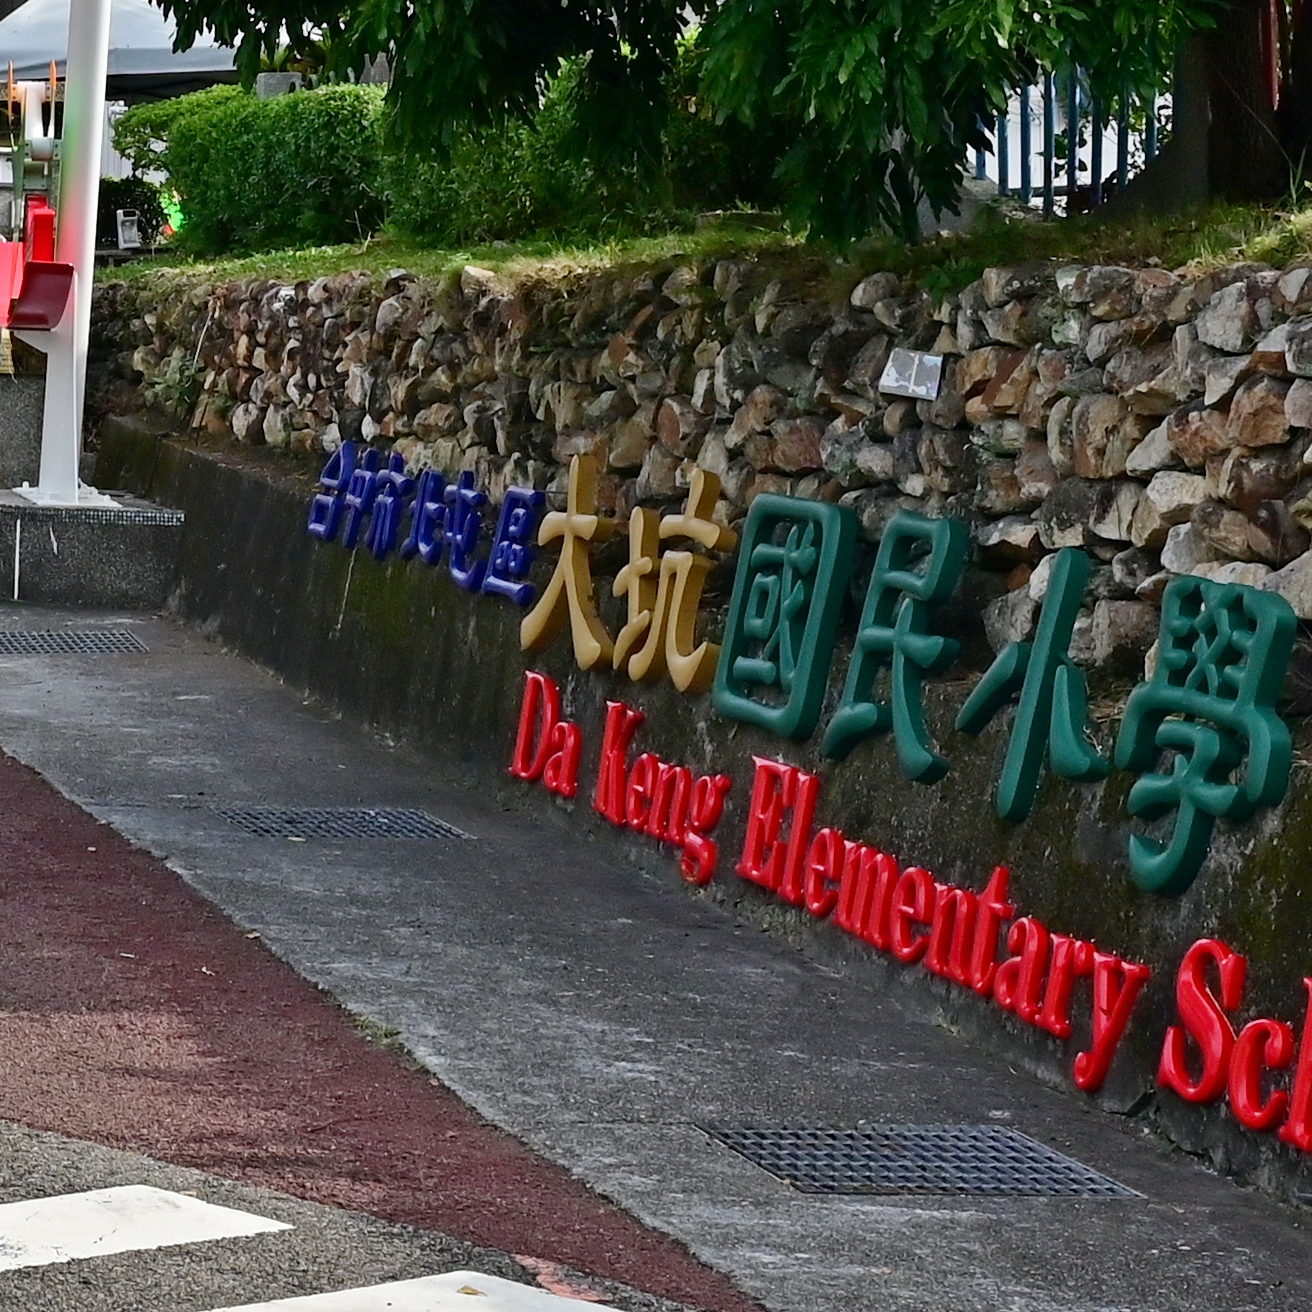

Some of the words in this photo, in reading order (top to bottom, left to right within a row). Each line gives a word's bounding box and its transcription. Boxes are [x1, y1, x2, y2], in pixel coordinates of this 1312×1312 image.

[508, 671, 581, 798] Da
[593, 700, 732, 886] Keng
[736, 756, 1150, 1091] Elementary
